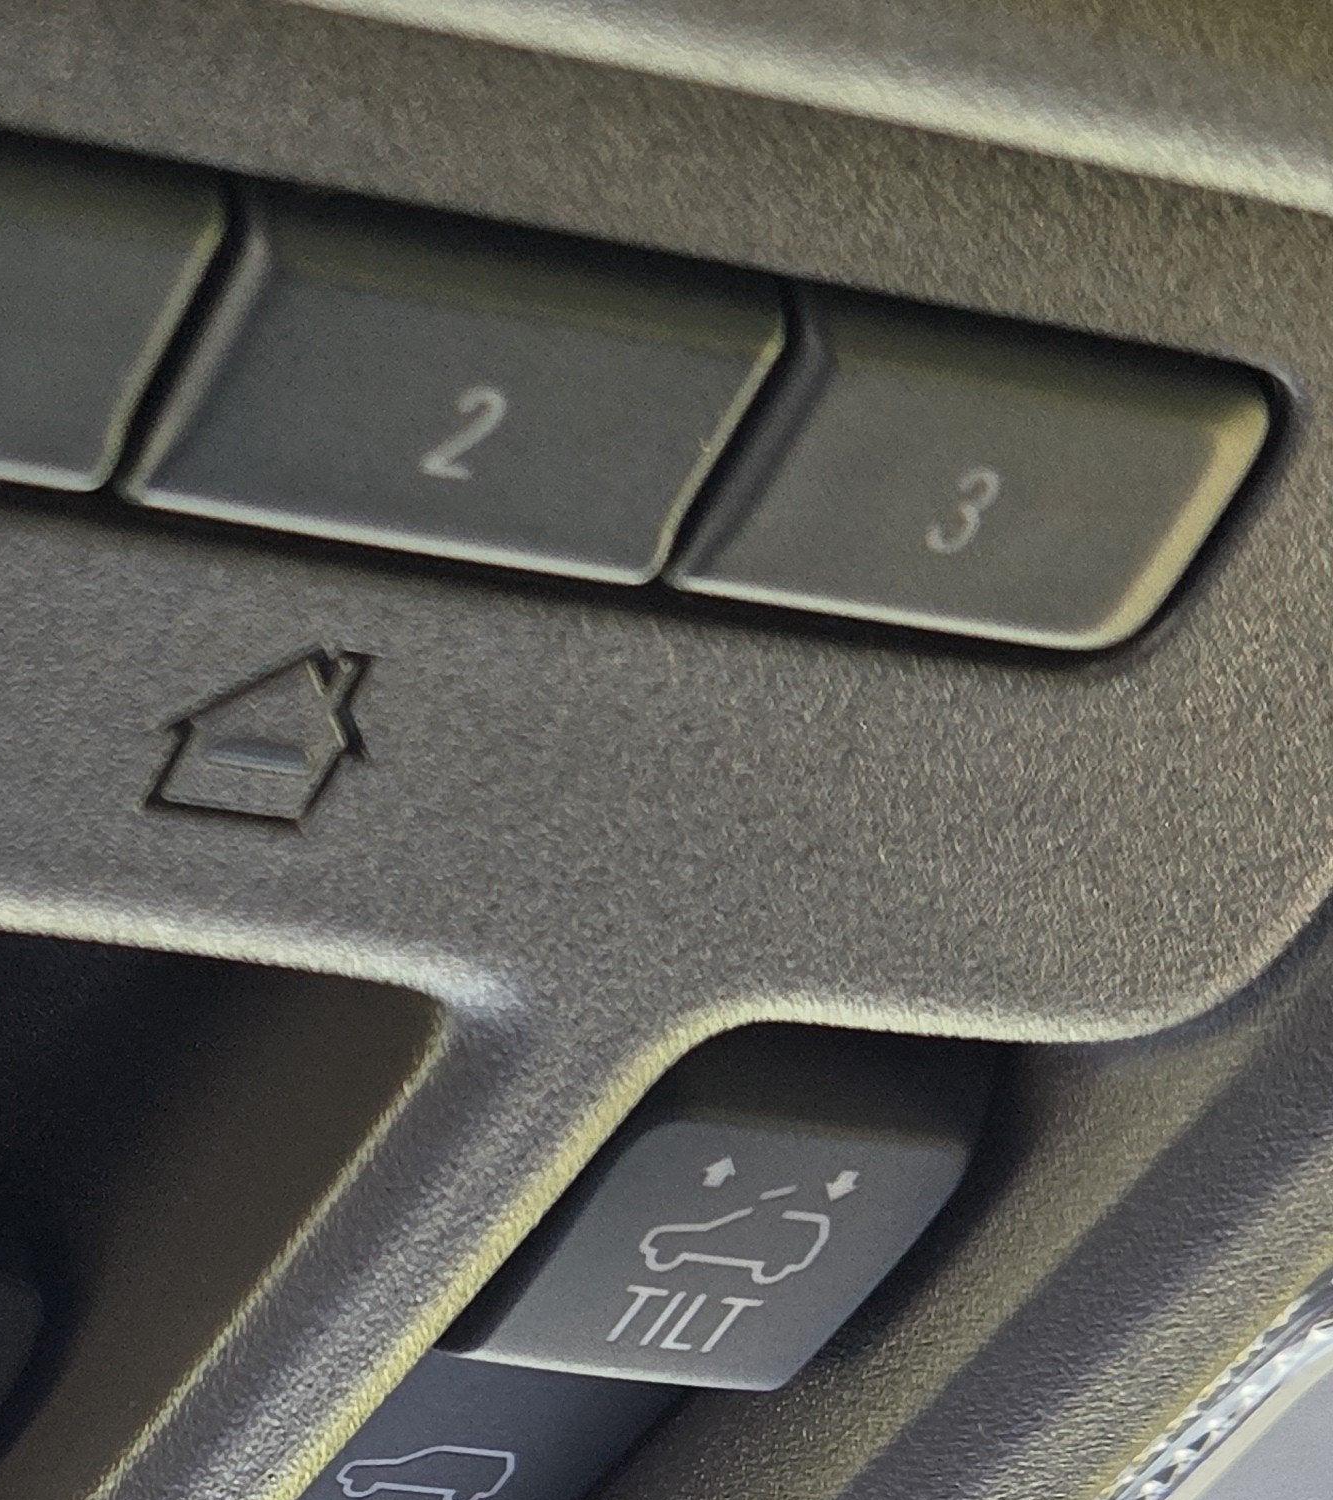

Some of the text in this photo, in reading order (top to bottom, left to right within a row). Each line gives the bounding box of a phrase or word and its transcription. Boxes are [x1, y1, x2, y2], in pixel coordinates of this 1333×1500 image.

[421, 385, 507, 479] 2
[924, 468, 1001, 553] 3
[606, 1284, 763, 1354] TILT
